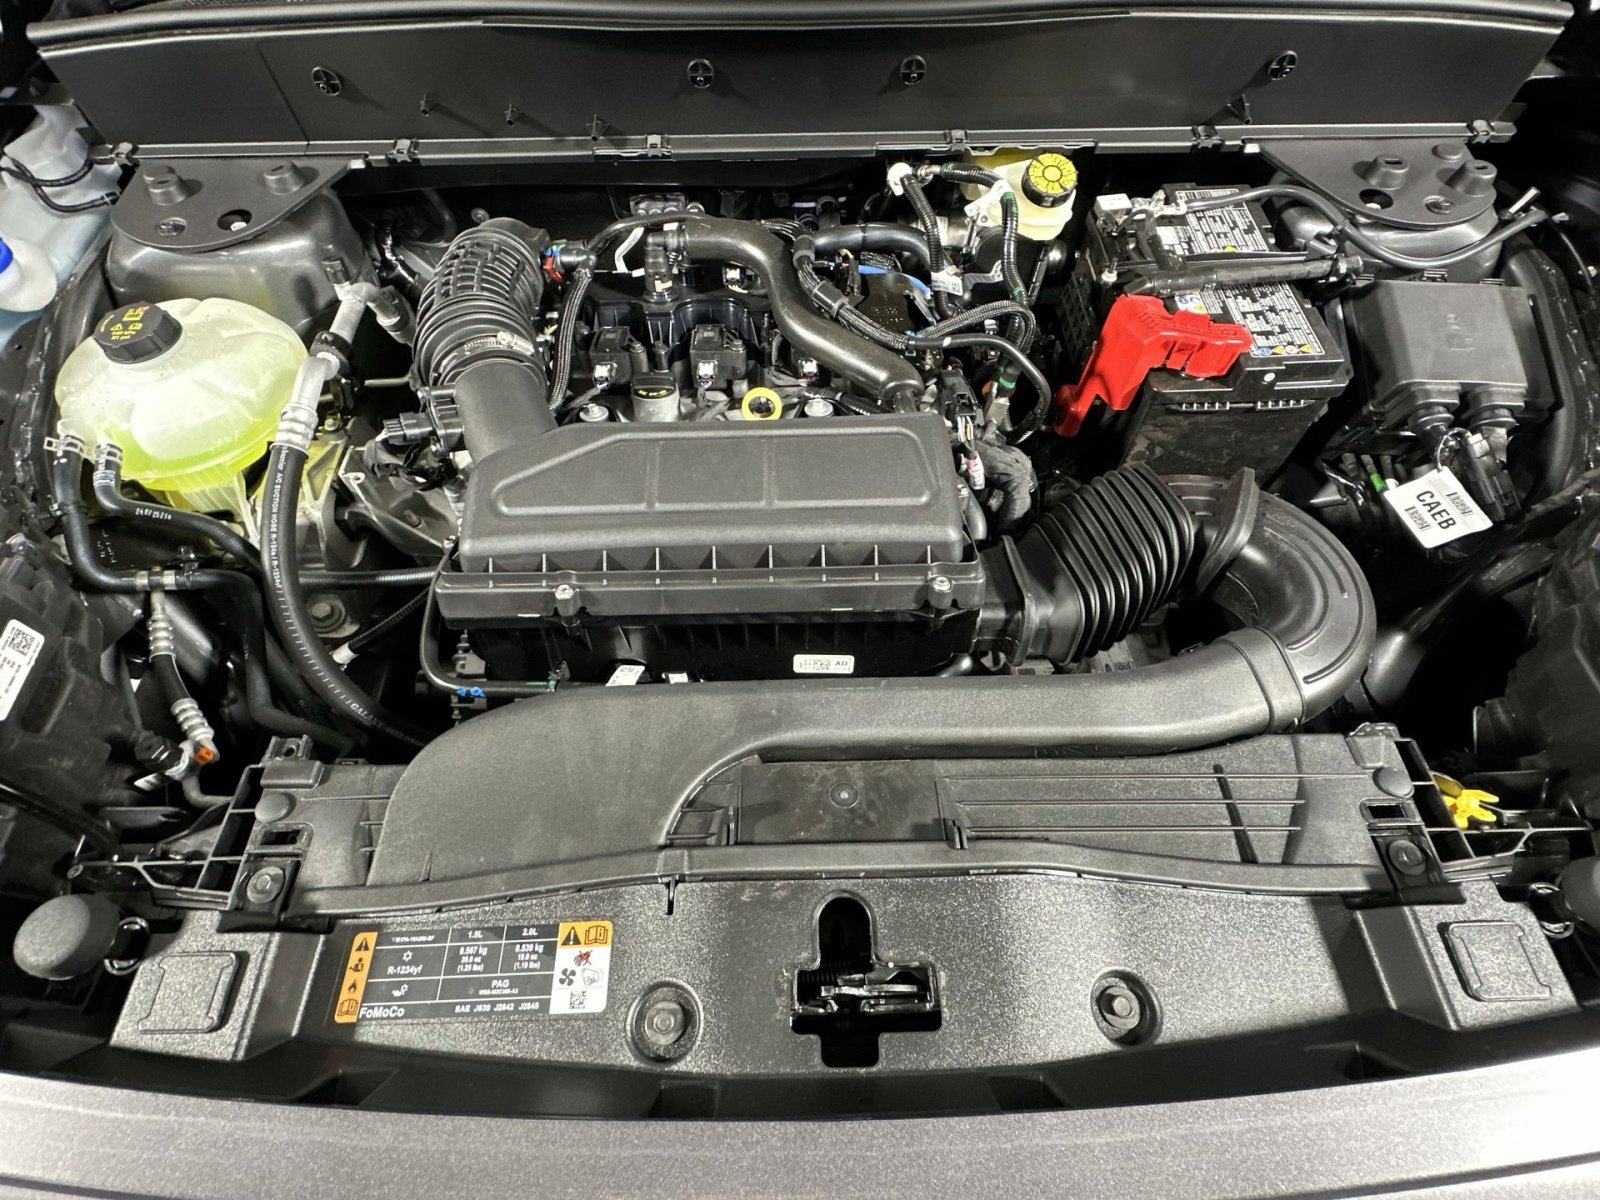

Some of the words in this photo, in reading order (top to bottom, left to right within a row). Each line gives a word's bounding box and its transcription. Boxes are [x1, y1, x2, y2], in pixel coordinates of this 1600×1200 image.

[275, 472, 284, 483] A/C
[272, 485, 280, 512] SUCTION
[1416, 490, 1456, 530] CAEB
[522, 928, 538, 936] 2.0L
[479, 946, 488, 956] kg
[535, 944, 544, 953] kg
[386, 964, 423, 976] R-1234yf
[491, 980, 510, 988] PAG
[358, 1006, 405, 1018] FoMoCo
[455, 1005, 471, 1013] SAE
[474, 1004, 491, 1012] J639
